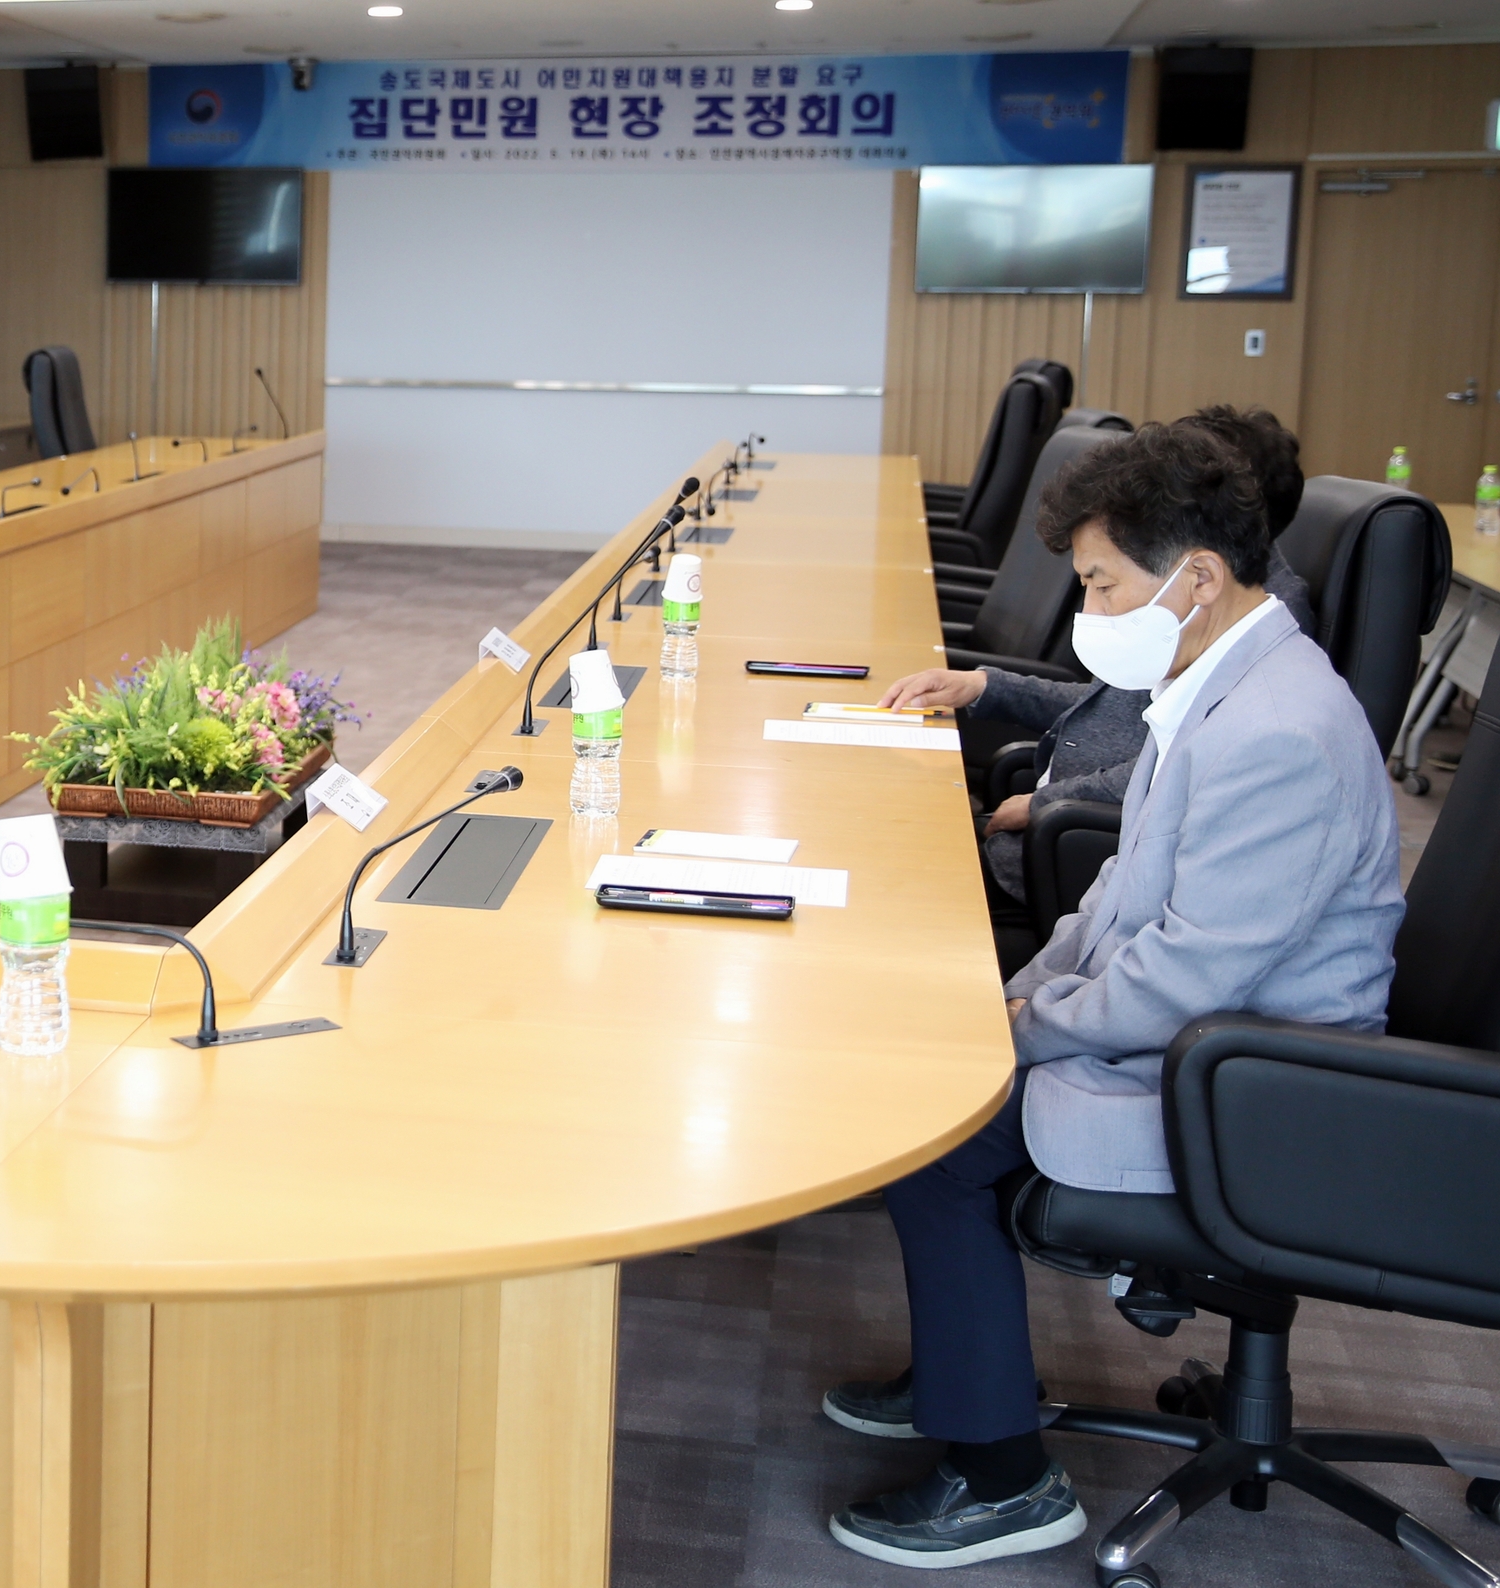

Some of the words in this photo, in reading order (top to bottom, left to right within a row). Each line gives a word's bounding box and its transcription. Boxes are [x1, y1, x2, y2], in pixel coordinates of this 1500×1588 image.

[379, 68, 520, 91] 송도국제도시
[537, 66, 734, 91] 어민지원대책용지
[752, 65, 799, 88] 분할
[816, 64, 864, 87] 요구
[349, 96, 538, 140] 집단민원
[569, 94, 664, 140] 현장
[693, 92, 896, 139] 조정회의
